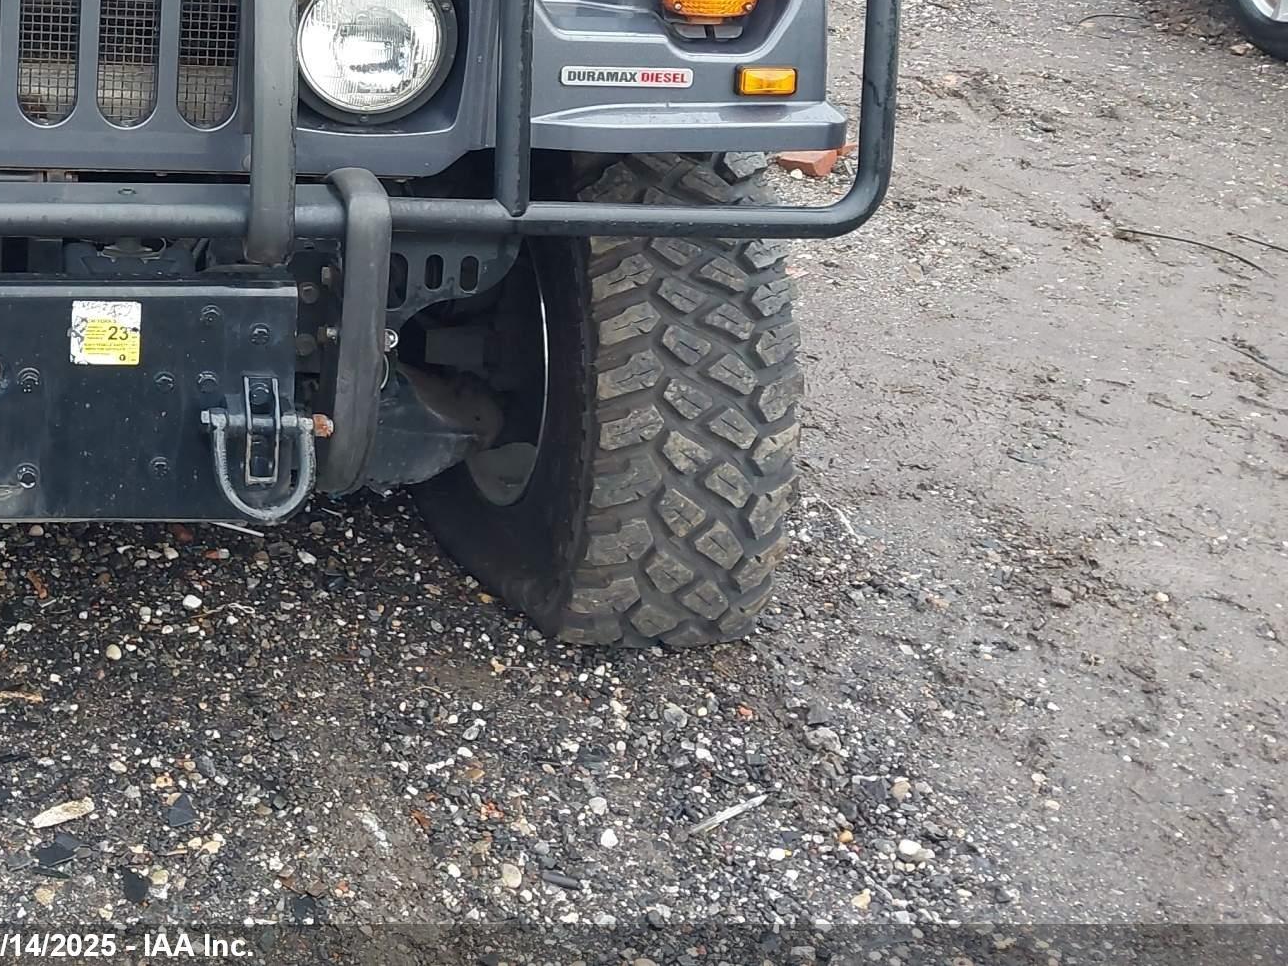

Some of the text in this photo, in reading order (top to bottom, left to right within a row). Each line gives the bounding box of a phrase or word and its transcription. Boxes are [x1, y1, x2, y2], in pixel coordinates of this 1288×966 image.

[567, 70, 688, 84] DURAMAX DIESEL
[108, 326, 129, 341] 23
